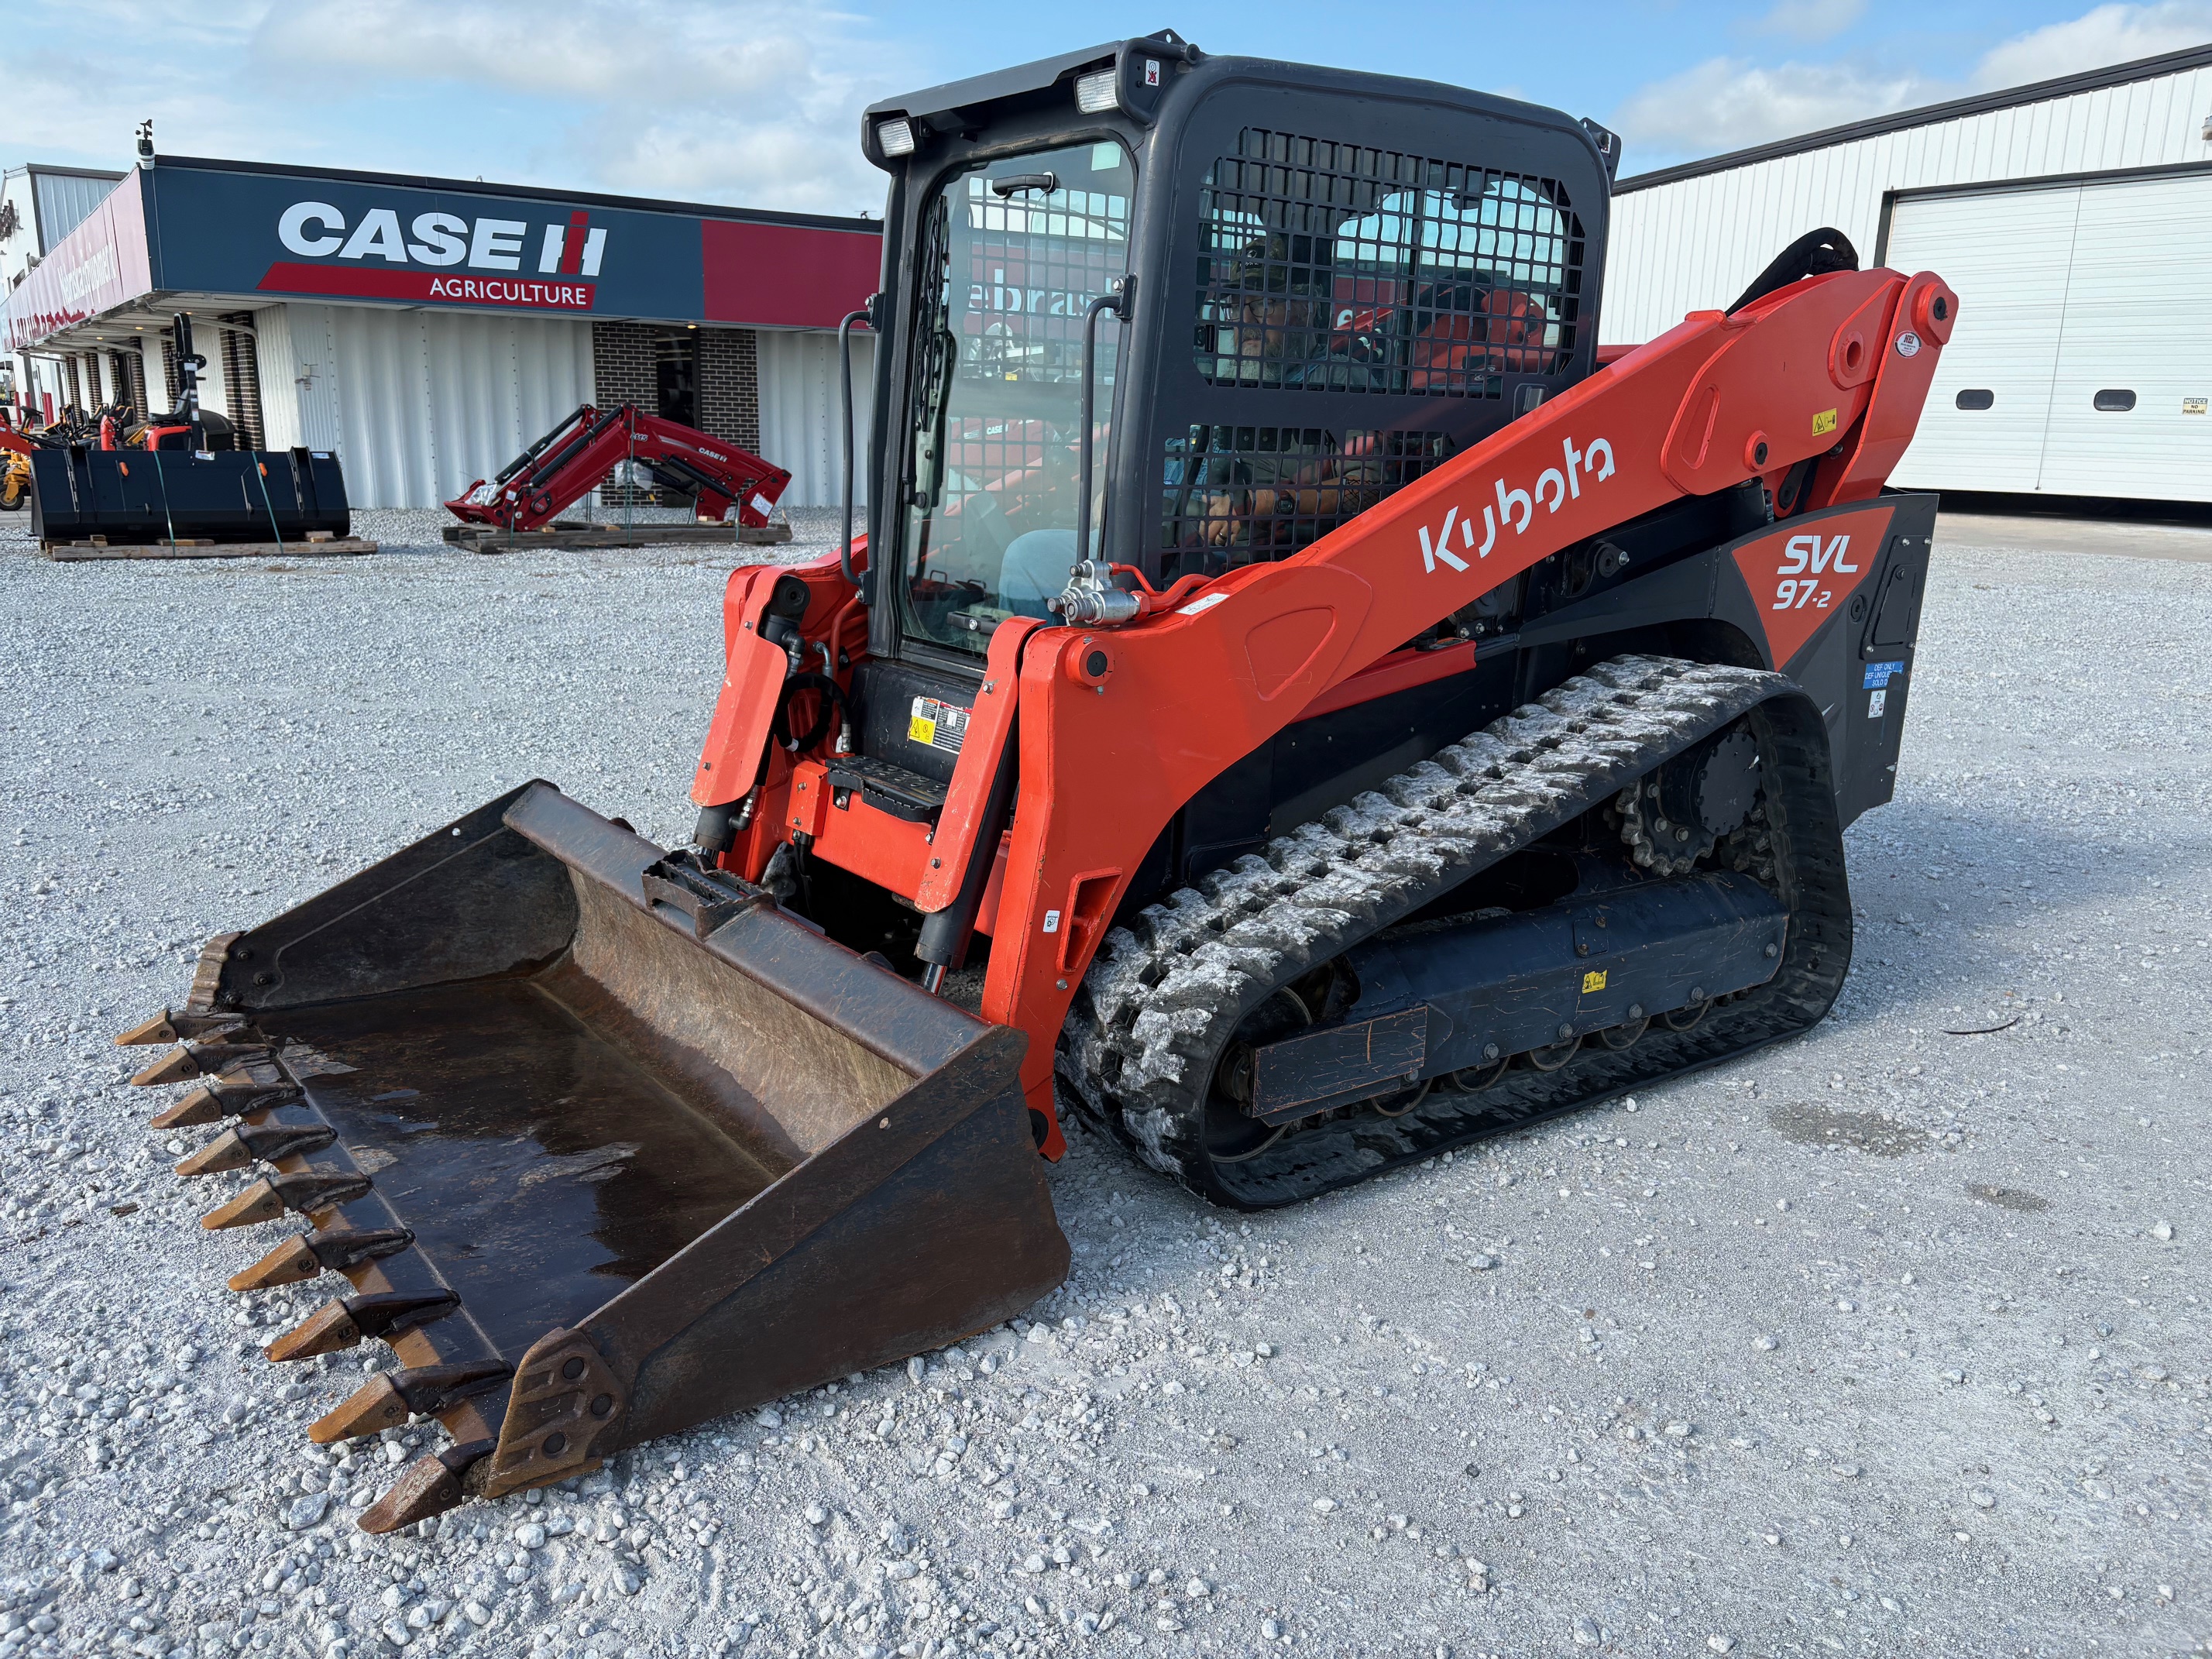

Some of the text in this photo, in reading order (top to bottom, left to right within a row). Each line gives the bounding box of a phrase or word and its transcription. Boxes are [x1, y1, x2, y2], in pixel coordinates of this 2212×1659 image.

[278, 201, 527, 270] CASE
[430, 278, 587, 306] AGRICULTURE
[699, 447, 720, 459] CASE
[1418, 436, 1616, 574] Kubota
[1777, 535, 1859, 575] SVL
[1772, 579, 1832, 610] 97-2
